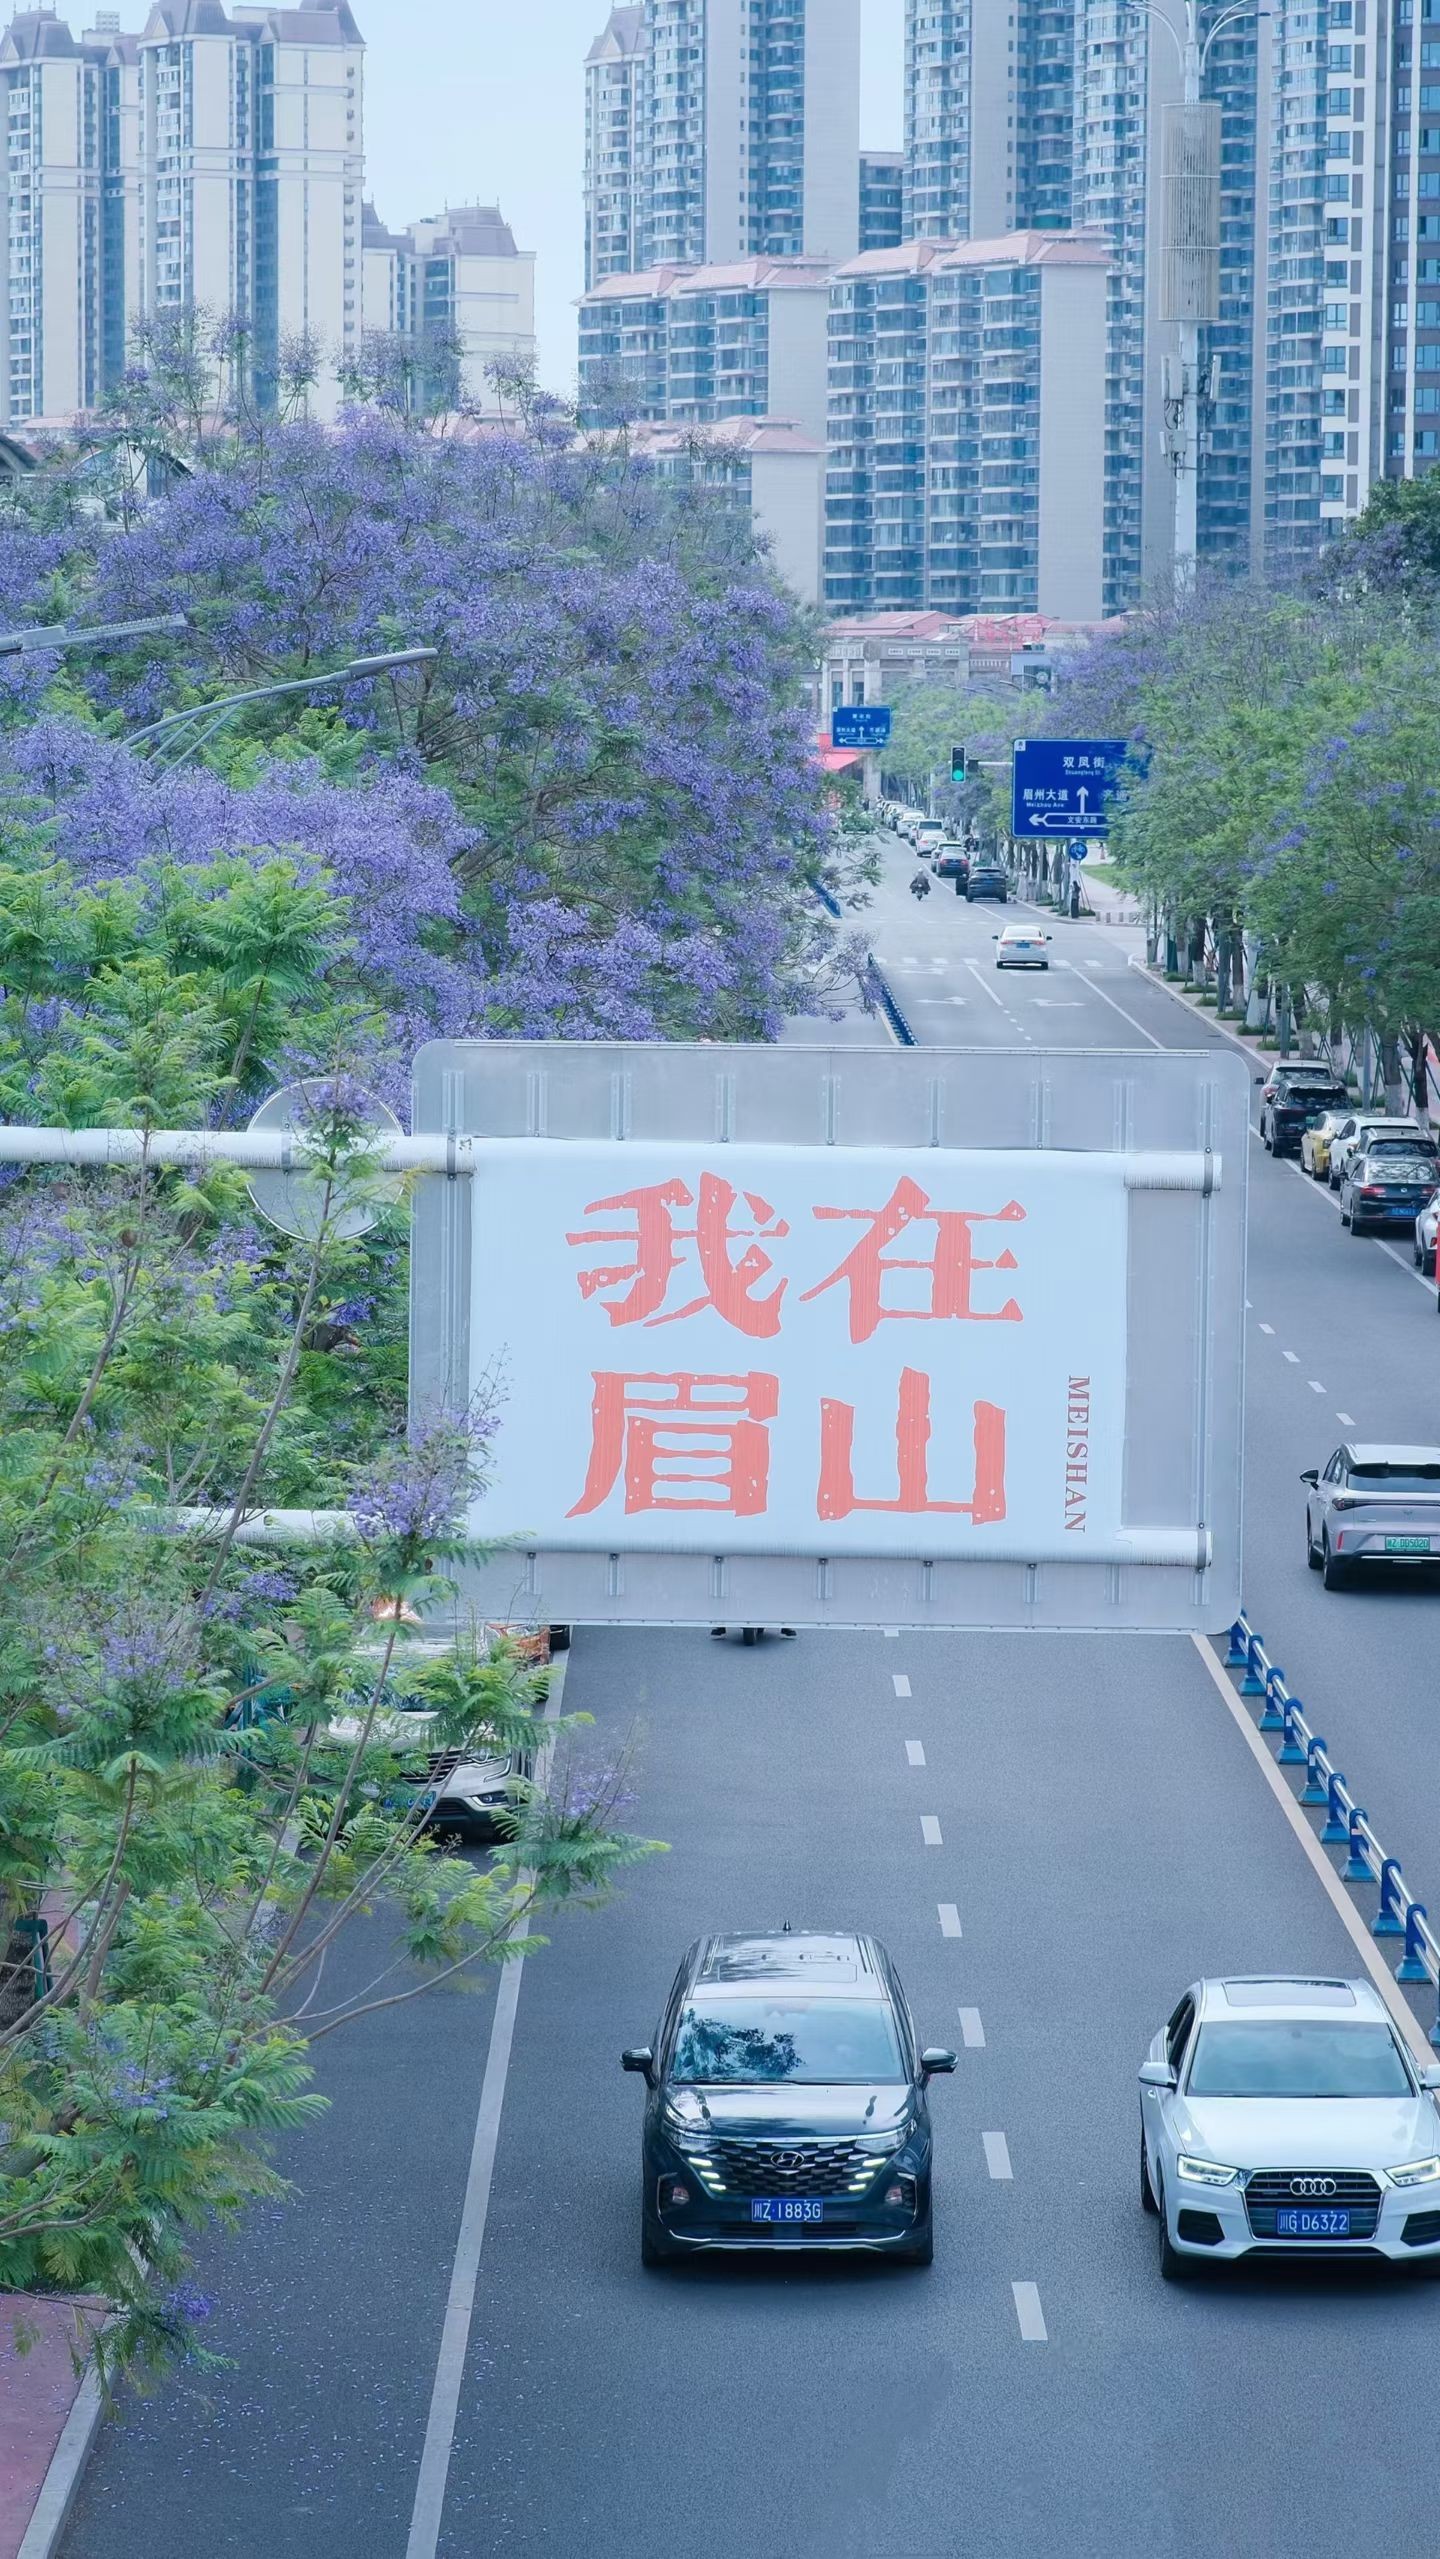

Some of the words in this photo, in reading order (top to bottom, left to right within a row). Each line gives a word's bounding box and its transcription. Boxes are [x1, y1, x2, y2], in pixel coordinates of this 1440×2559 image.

[1023, 788, 1069, 800] 眉州大道
[1062, 756, 1105, 768] 双凤街
[565, 1171, 1027, 1344] 我在
[564, 1366, 1006, 1525] 眉山
[1064, 1375, 1091, 1533] MEISHAN
